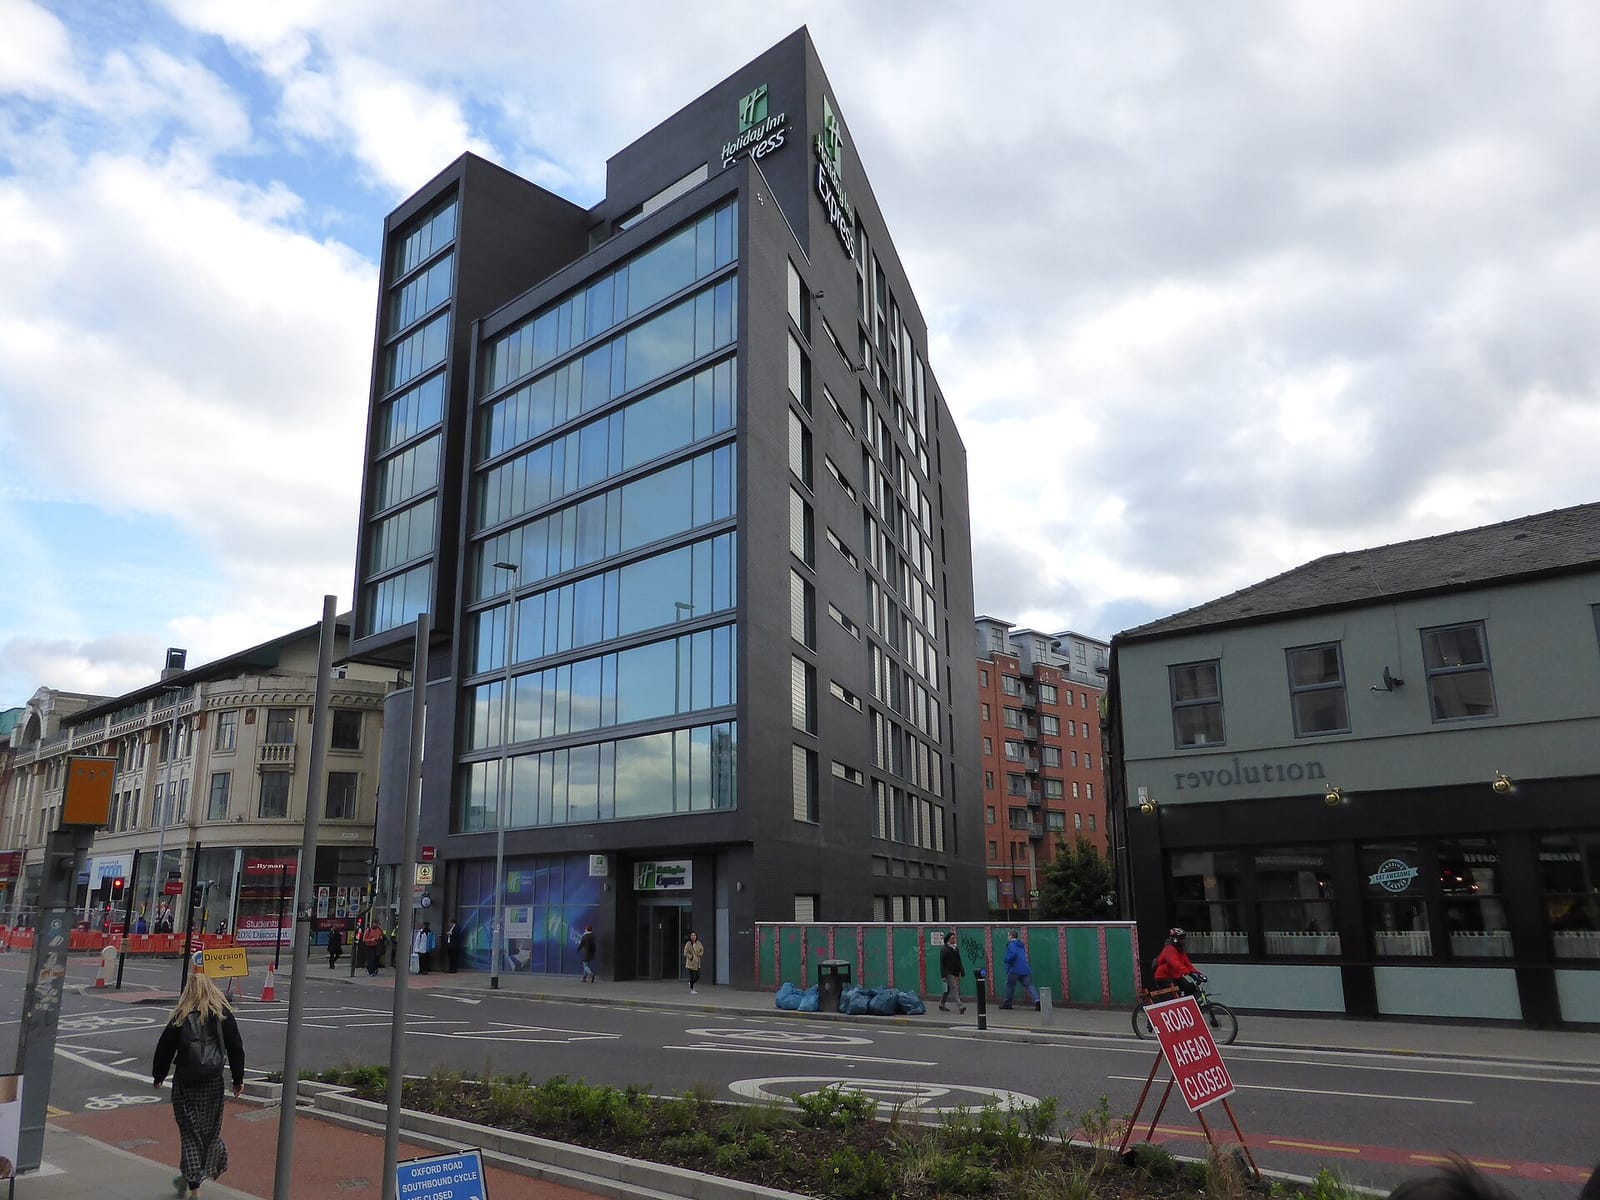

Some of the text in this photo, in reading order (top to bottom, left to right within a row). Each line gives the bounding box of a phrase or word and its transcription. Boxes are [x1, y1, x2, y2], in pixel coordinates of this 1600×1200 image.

[721, 113, 785, 160] Holiday Inn
[723, 129, 785, 168] ress
[816, 134, 844, 208] Holiday
[817, 163, 855, 260] Express
[1174, 756, 1327, 790] revolution
[1386, 870, 1411, 879] AWESOME
[246, 919, 279, 928] Students
[204, 953, 244, 961] Diversion
[1160, 1006, 1195, 1033] ROAD
[1172, 1035, 1212, 1067] AHEAD
[1184, 1065, 1227, 1101] CLOSED
[402, 1171, 477, 1193] SOUTHBOUND CYCLE
[411, 1161, 464, 1177] OXFORD ROAD
[423, 1190, 453, 1200] CLOSED
